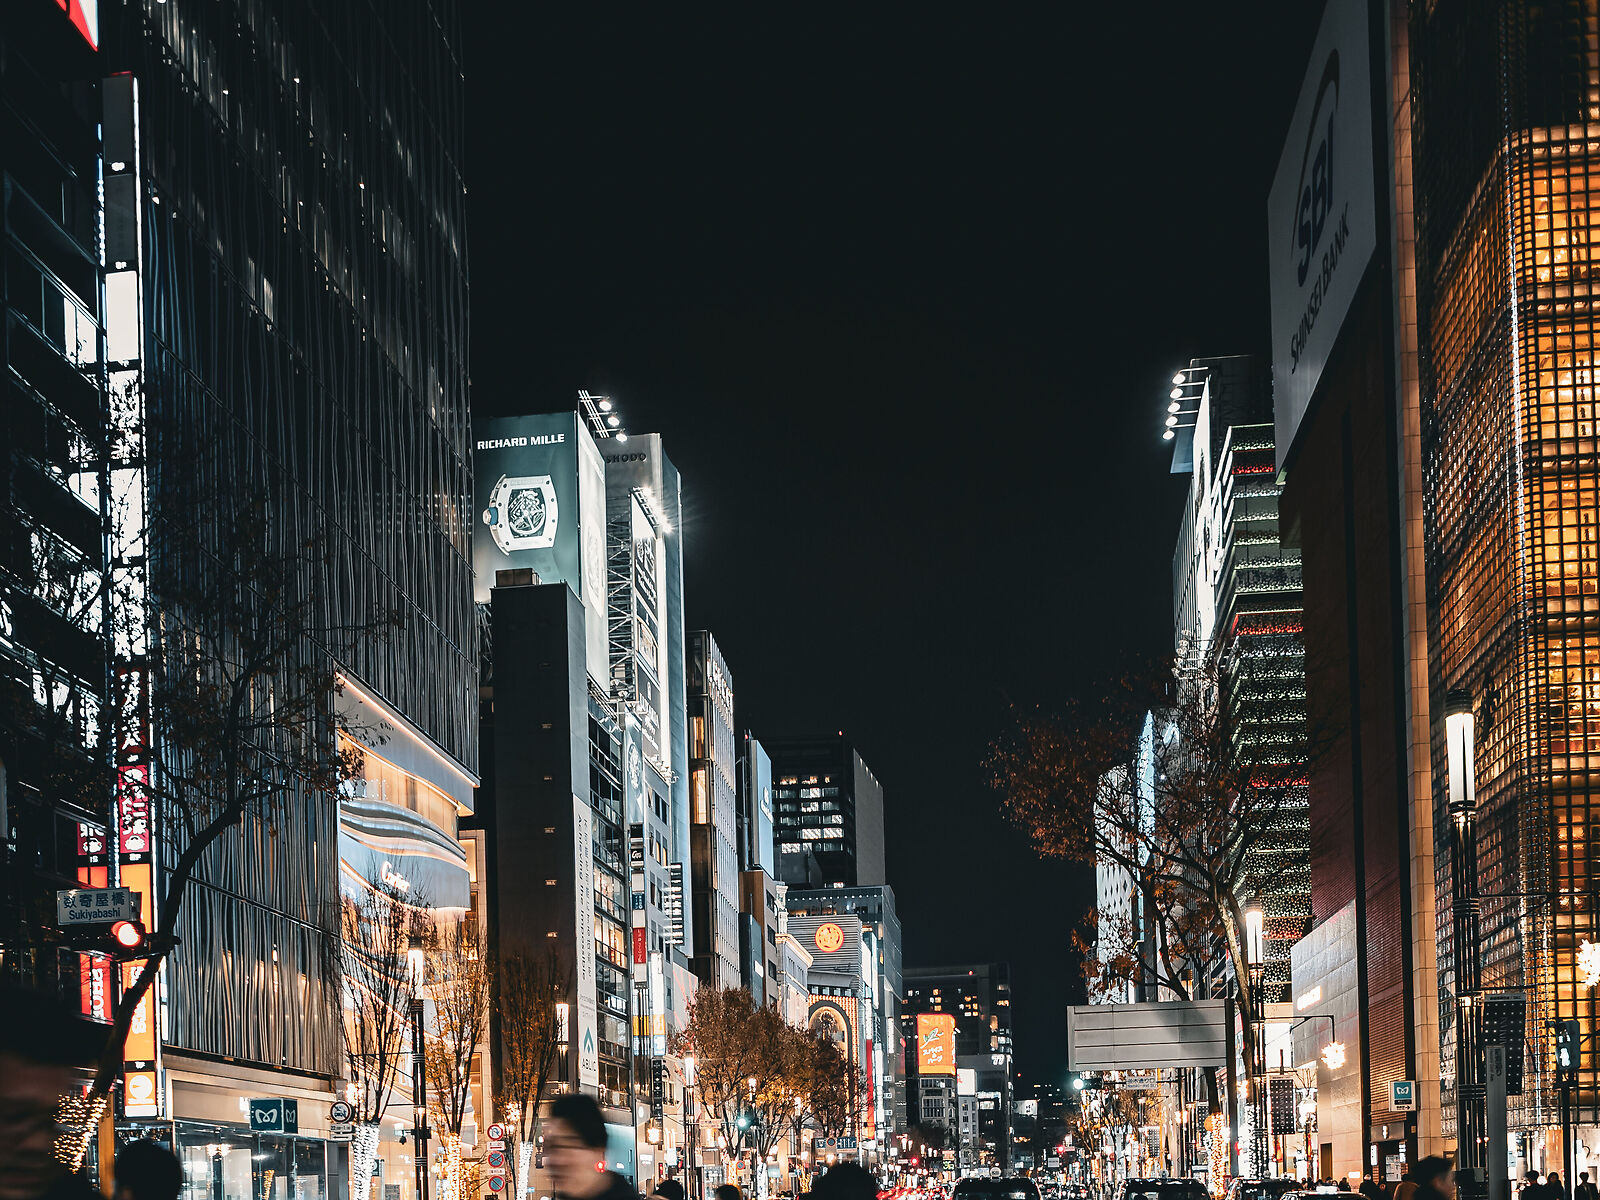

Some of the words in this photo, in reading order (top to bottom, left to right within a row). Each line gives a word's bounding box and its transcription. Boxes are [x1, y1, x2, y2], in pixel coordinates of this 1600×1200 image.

[1297, 111, 1334, 288] SBI
[1291, 273, 1322, 375] SHINSEI
[1322, 202, 1350, 297] BANK
[477, 437, 527, 450] RICHARD
[530, 433, 565, 446] MILLE
[63, 892, 125, 909] 数寄屋橋
[69, 907, 121, 921] Sukiyabashi
